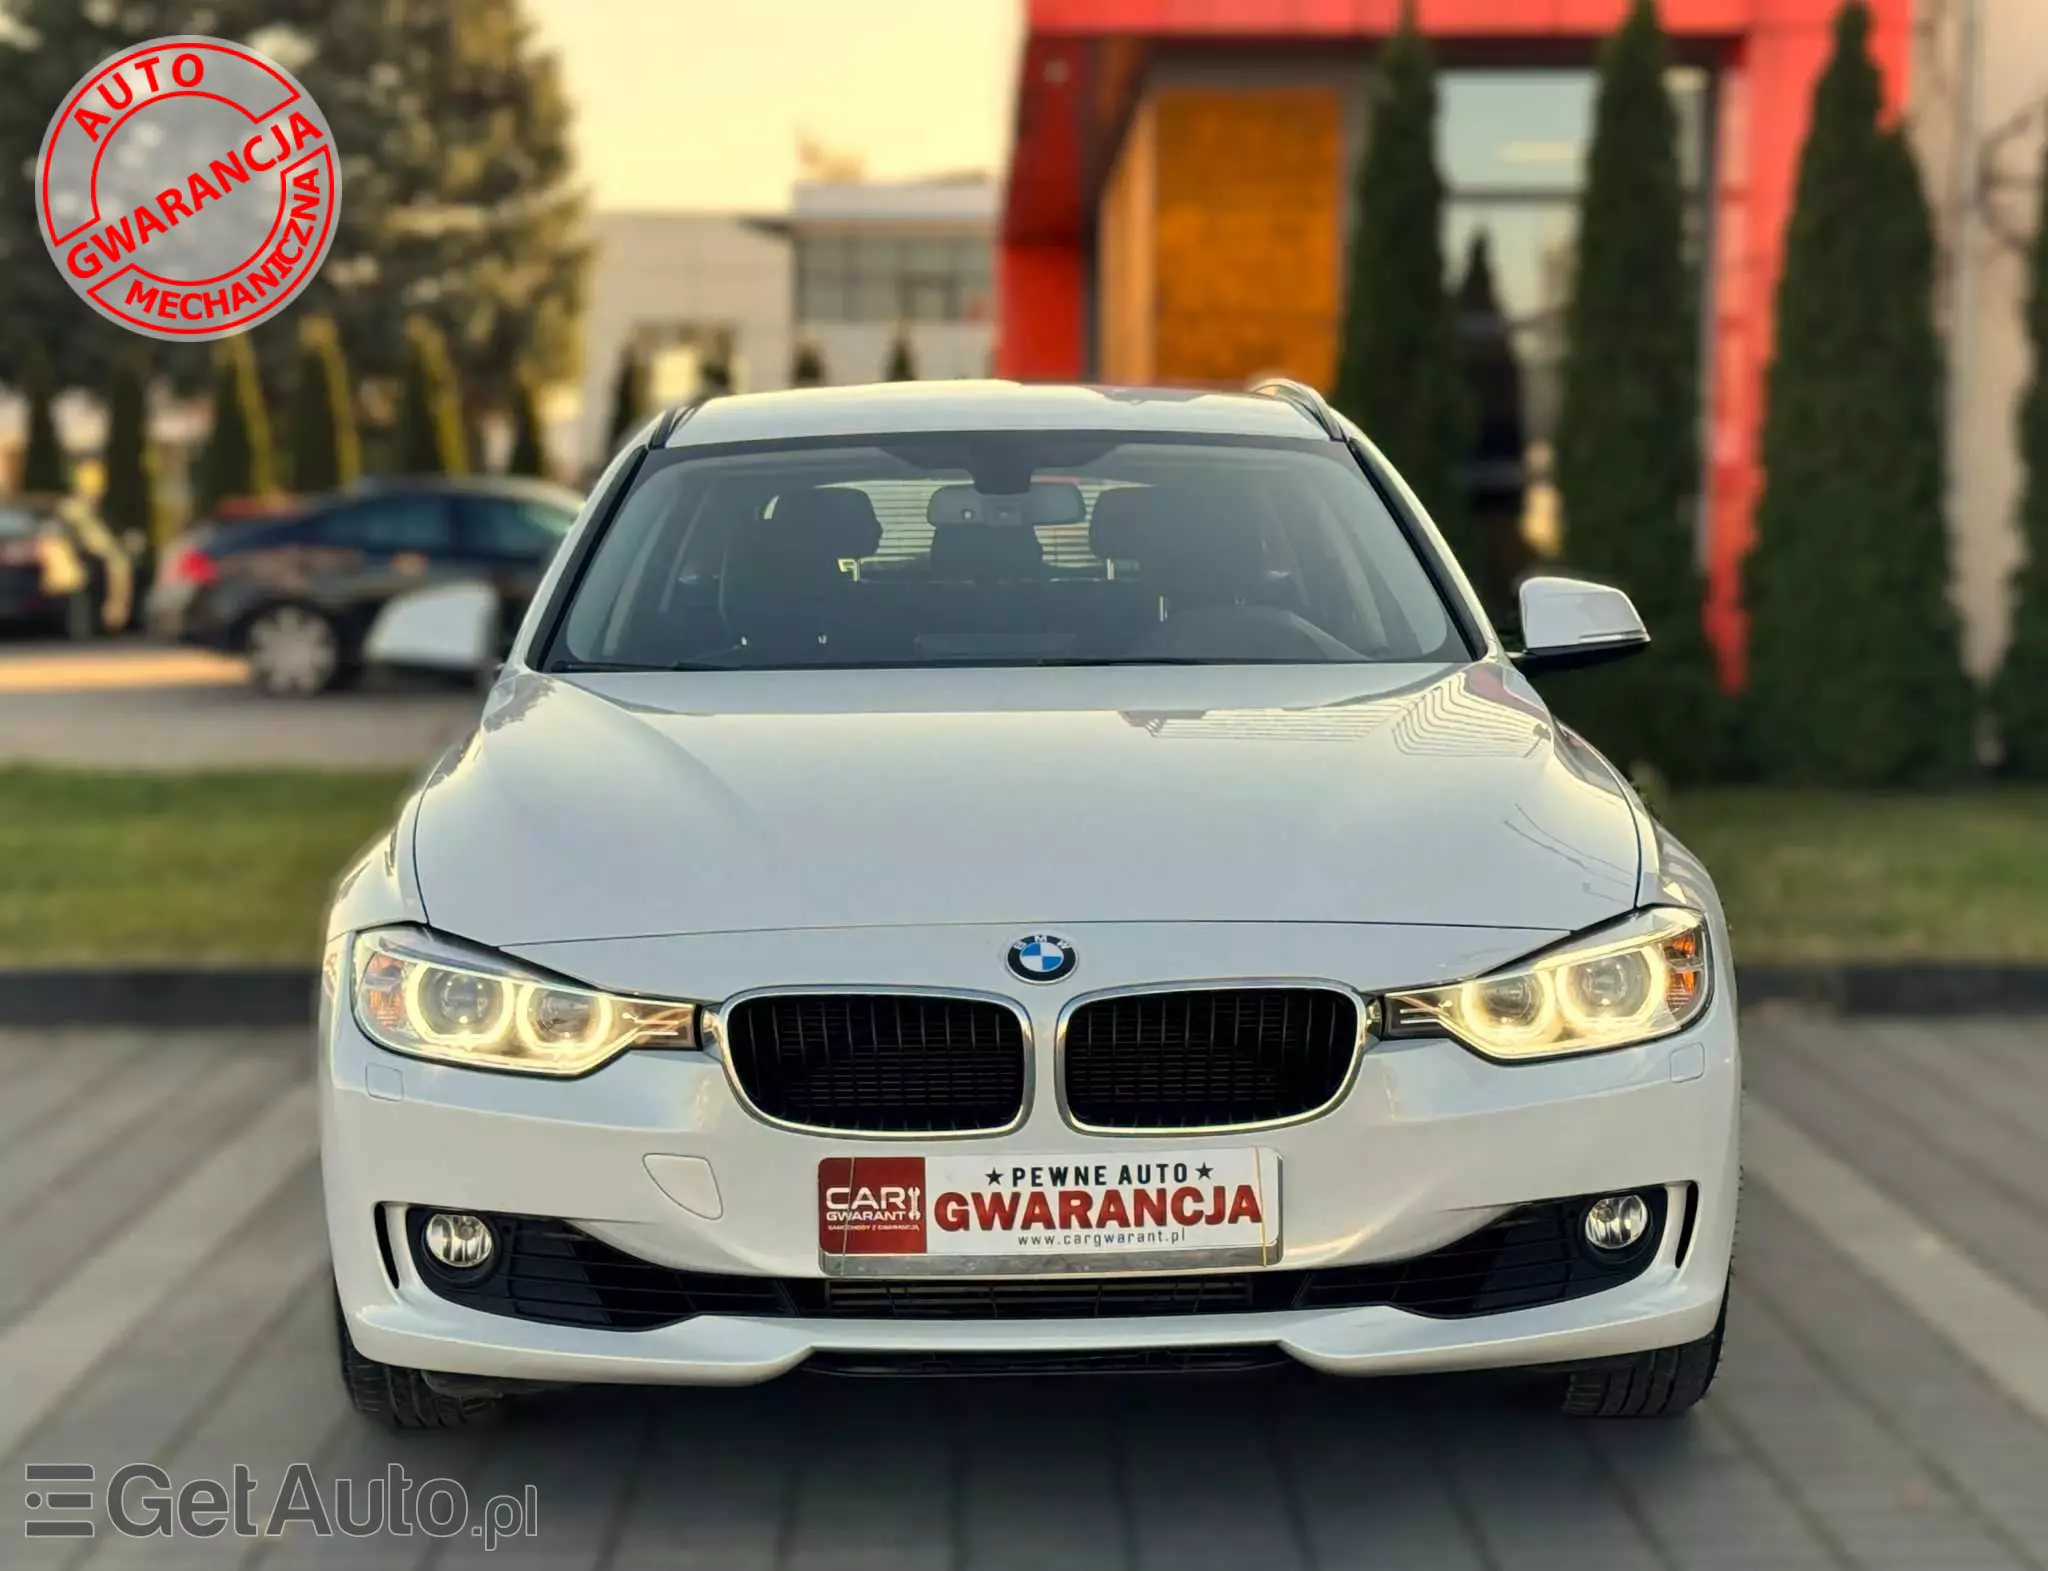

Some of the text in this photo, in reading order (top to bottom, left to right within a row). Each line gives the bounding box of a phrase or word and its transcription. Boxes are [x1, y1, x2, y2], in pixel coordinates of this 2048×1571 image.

[1012, 935, 1073, 950] BMW
[1012, 1162, 1188, 1188] PEWNE AUTO
[825, 1186, 907, 1210] CAR
[934, 1184, 1263, 1232] GWARANCJA
[826, 1210, 907, 1221] GWARANT
[1017, 1227, 1186, 1248] www.cargwarant.pl
